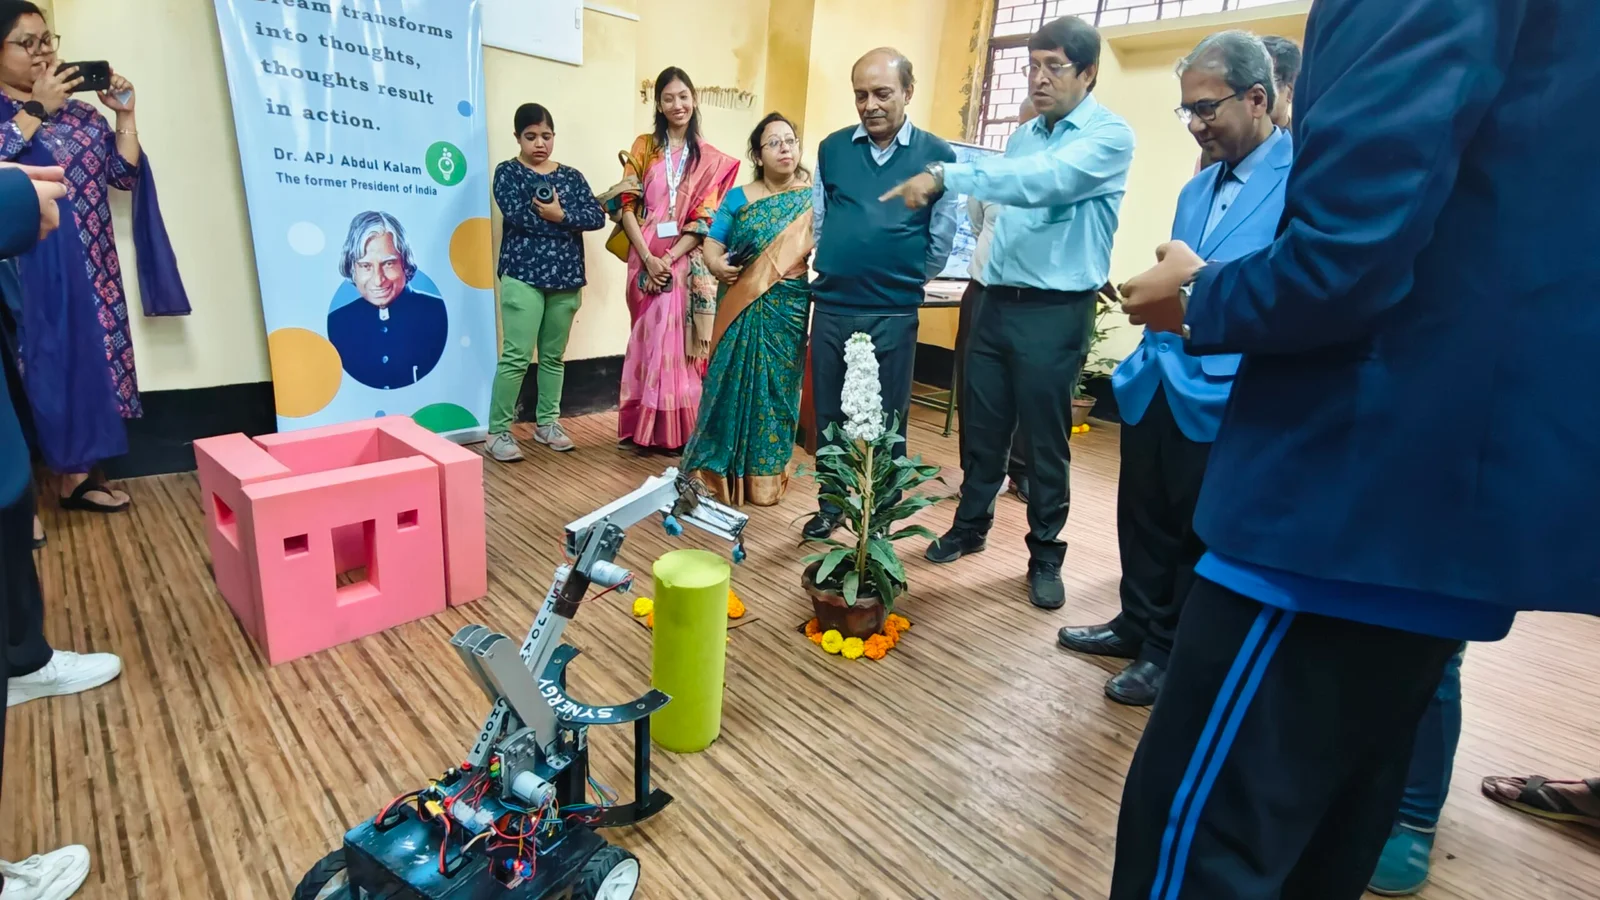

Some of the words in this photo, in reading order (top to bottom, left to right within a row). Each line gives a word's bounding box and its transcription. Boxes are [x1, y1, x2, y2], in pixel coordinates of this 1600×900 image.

[341, 4, 453, 39] transforms
[255, 22, 308, 43] into
[318, 33, 421, 69] thoughts,
[260, 58, 369, 92] thoughts
[377, 80, 434, 105] result
[266, 98, 292, 118] in
[302, 107, 381, 131] action.
[274, 147, 297, 162] Dr.
[304, 151, 334, 165] APJ
[341, 155, 379, 171] Abdul
[383, 160, 422, 175] Kalam
[276, 172, 300, 186] The
[304, 173, 347, 189] former
[351, 177, 399, 193] President
[403, 183, 413, 195] of
[415, 184, 437, 196] India
[538, 678, 614, 719] SYNERGY
